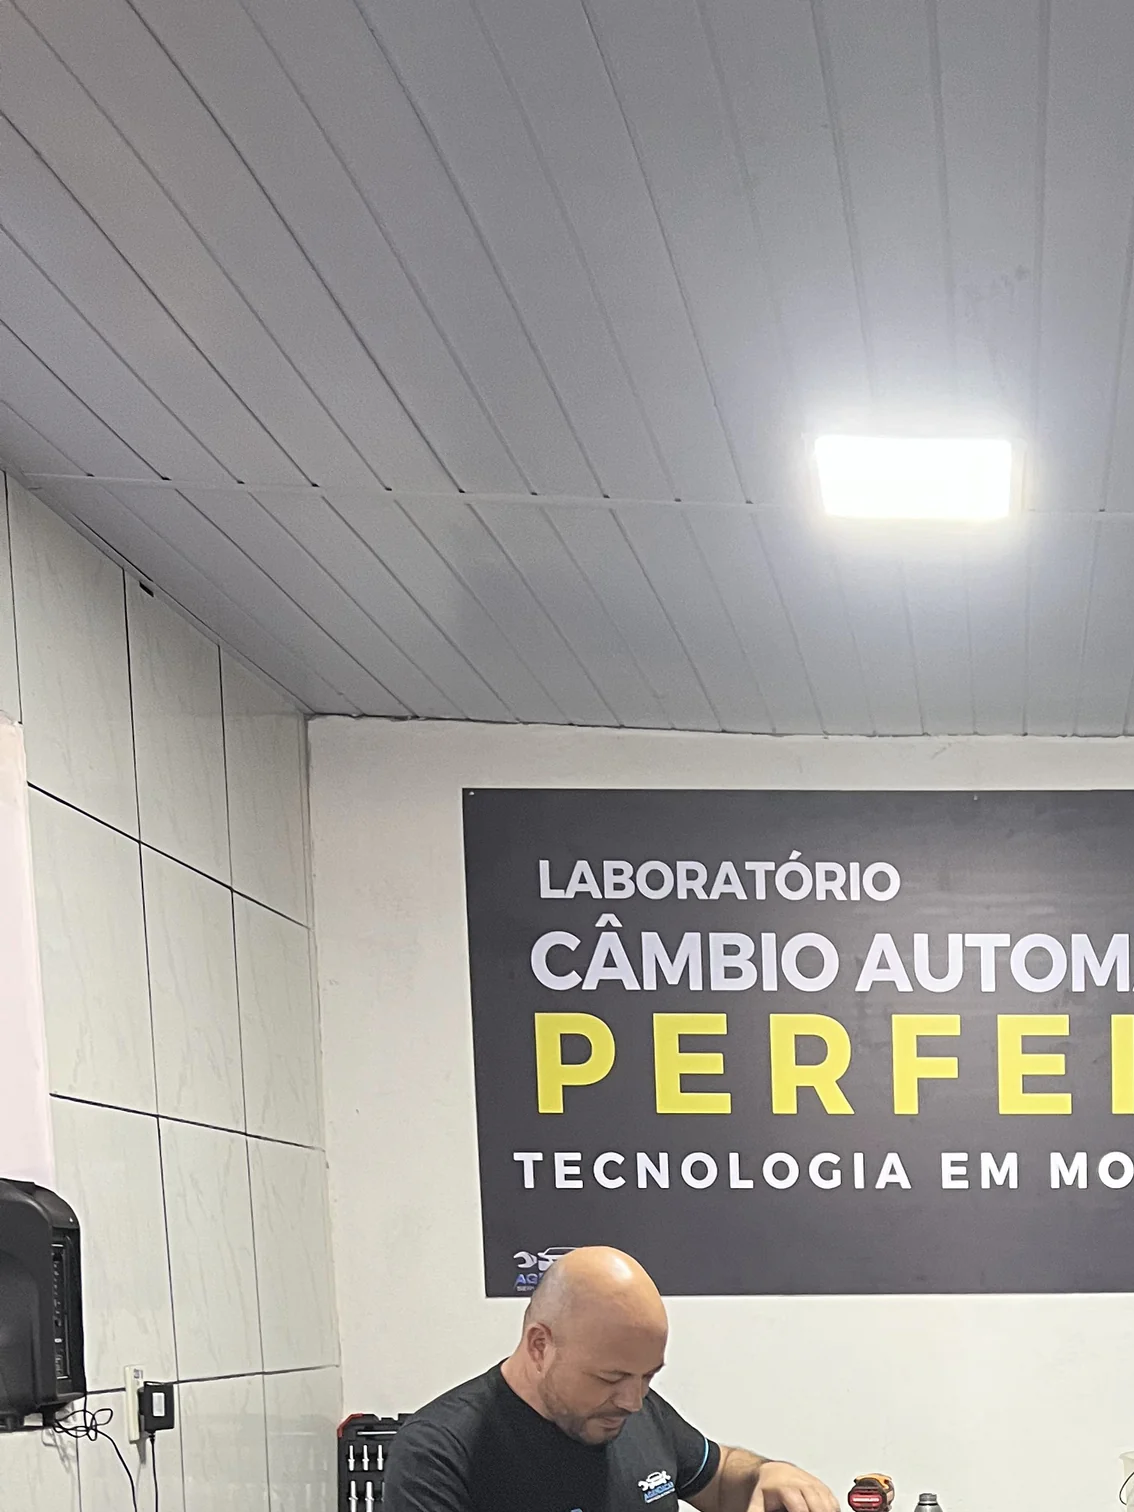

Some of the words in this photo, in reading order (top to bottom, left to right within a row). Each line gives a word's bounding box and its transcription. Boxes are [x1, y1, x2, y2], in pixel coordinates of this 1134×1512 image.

[538, 850, 901, 902] LABORATÓRIO
[530, 913, 840, 992] CÂMBIO
[513, 1151, 912, 1190] TECNOLOGIA
[940, 1151, 1019, 1190] EM
